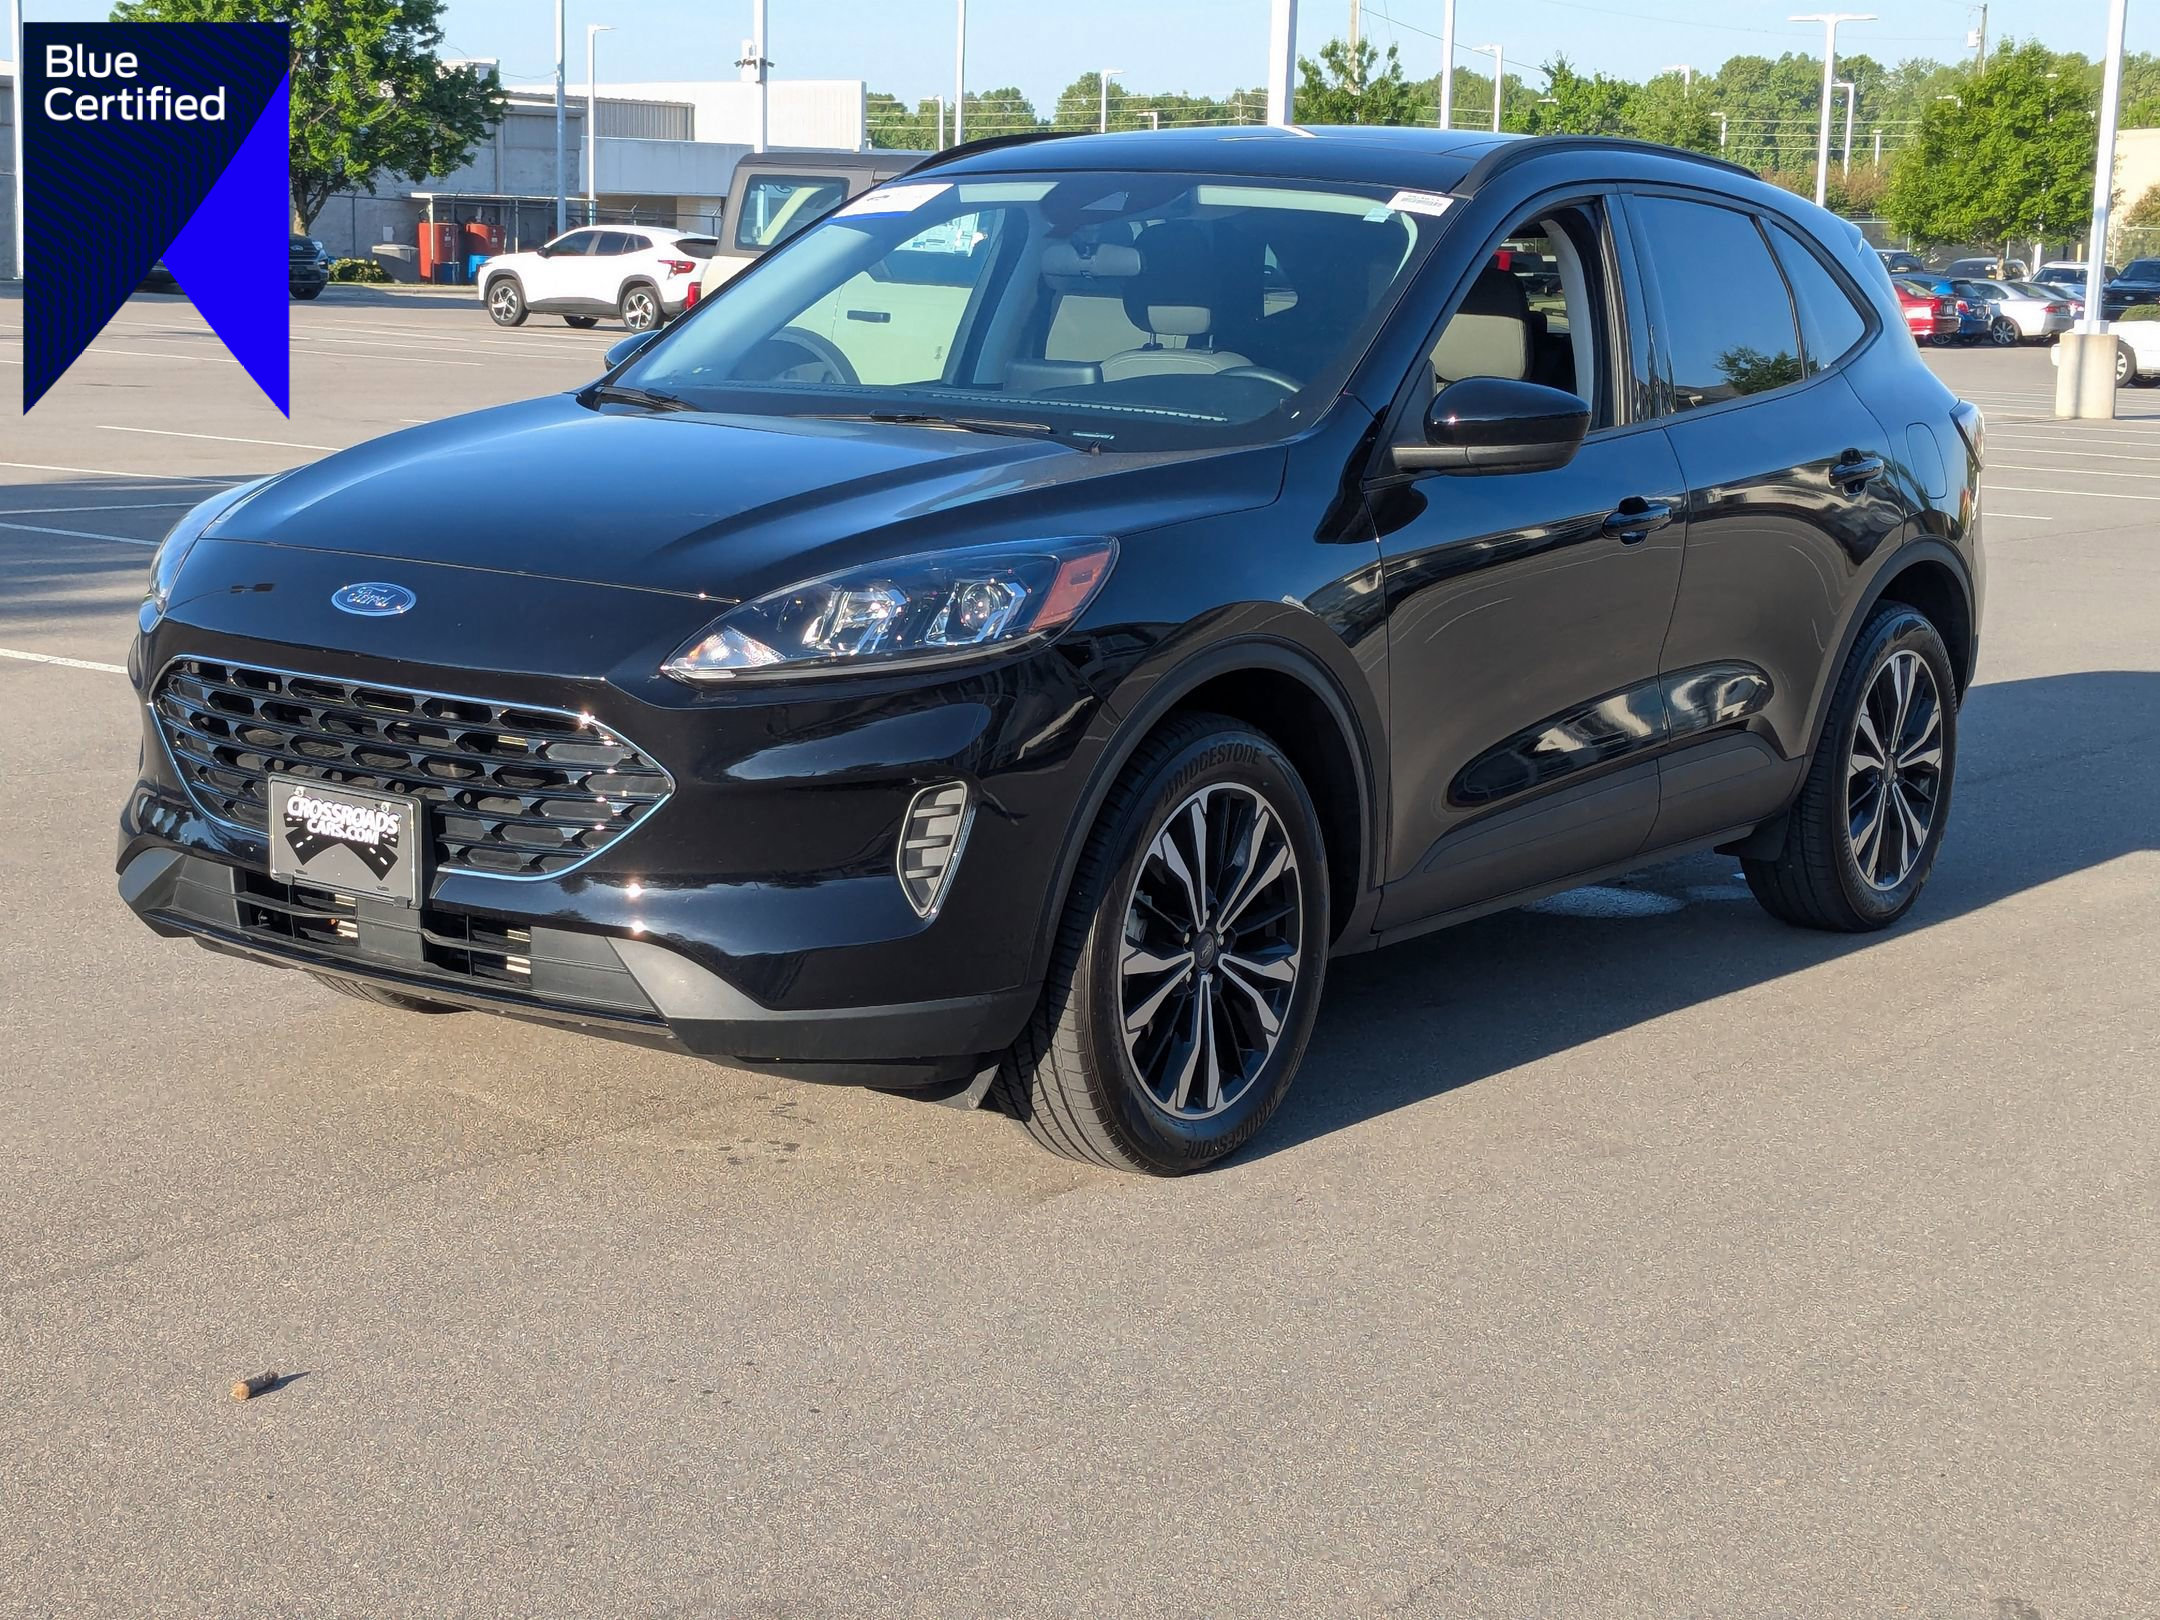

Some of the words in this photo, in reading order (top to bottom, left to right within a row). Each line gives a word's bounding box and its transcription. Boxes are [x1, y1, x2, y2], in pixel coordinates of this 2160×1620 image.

[346, 586, 397, 607] Ford
[1162, 743, 1262, 807] BRIDGESTONE
[287, 795, 401, 835] CROSSROADS
[306, 818, 380, 845] CARS.COM
